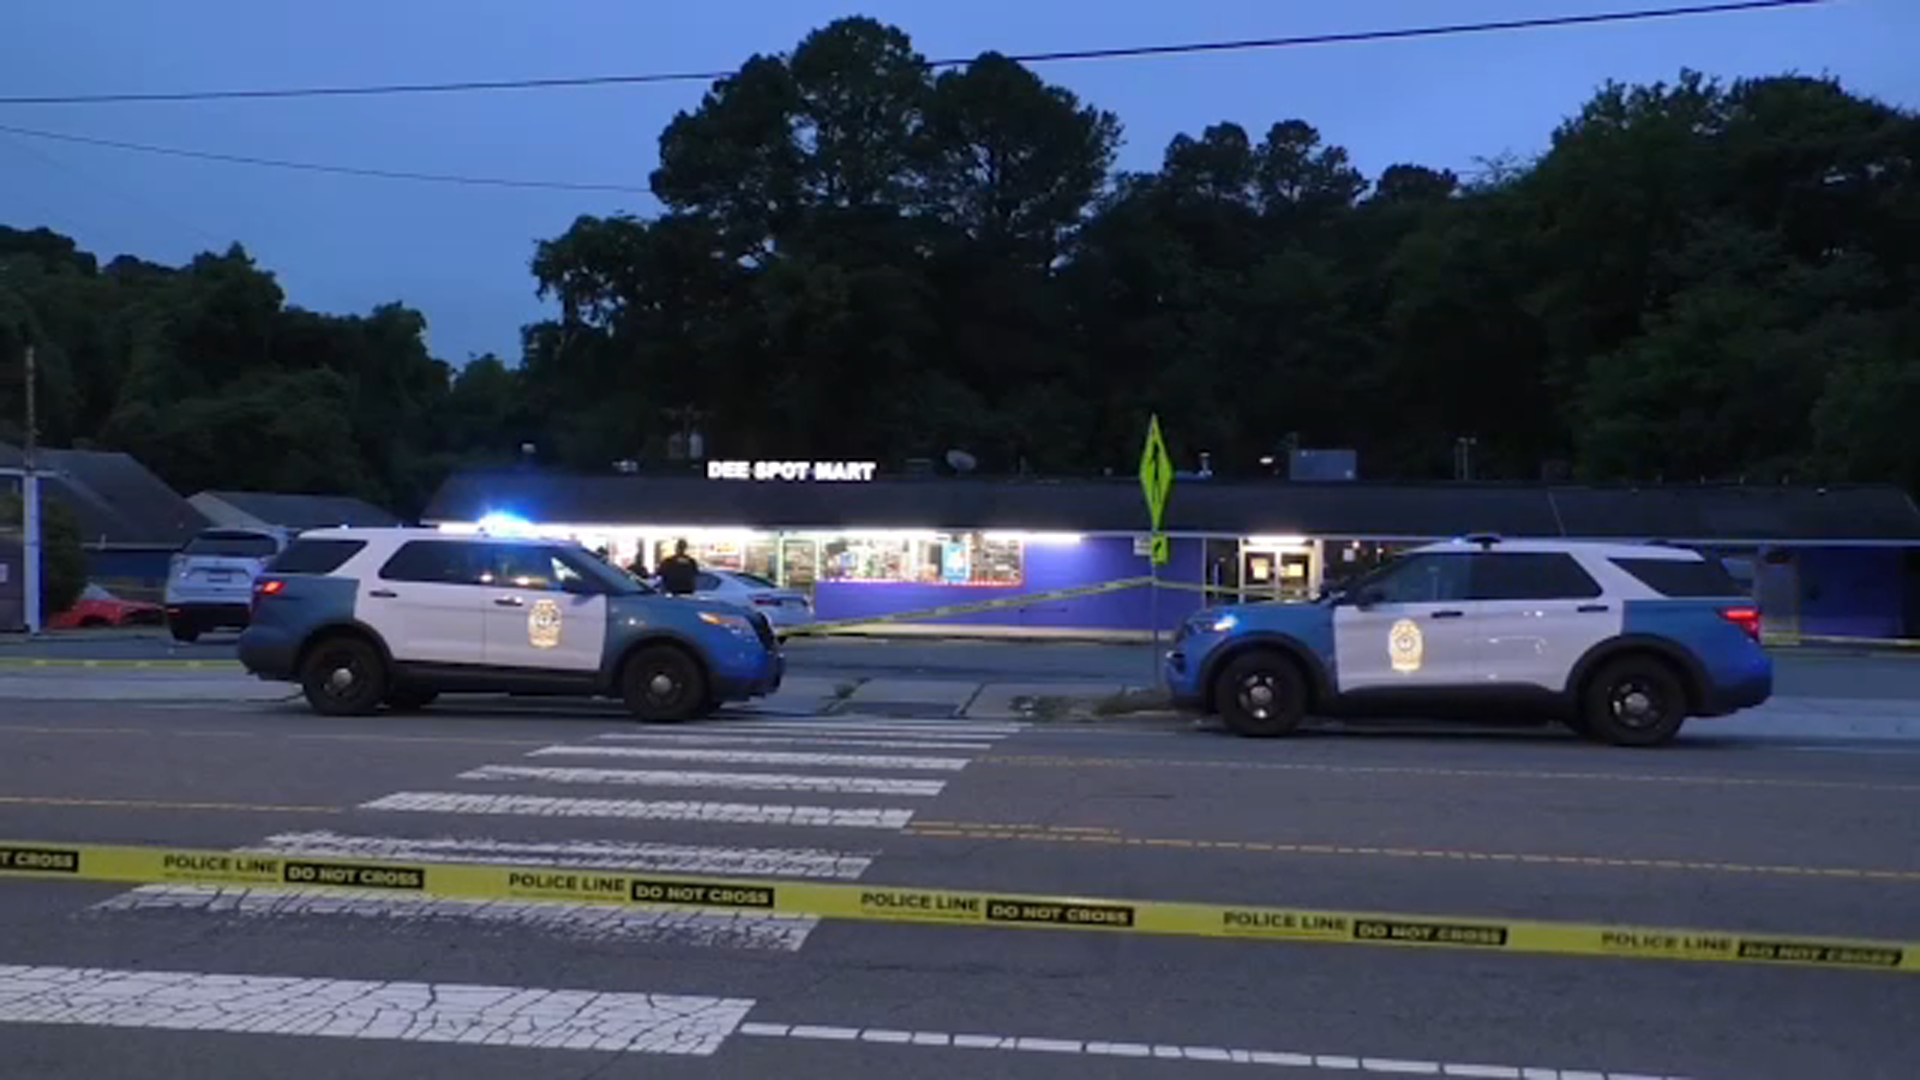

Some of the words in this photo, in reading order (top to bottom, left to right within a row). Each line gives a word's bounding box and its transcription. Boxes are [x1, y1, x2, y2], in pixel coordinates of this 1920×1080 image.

[707, 461, 750, 478] DEE
[754, 461, 810, 480] SPOT
[814, 462, 876, 481] MART
[14, 853, 74, 868] CROSS
[163, 855, 231, 871] POLICE
[236, 859, 278, 873] LINE
[287, 866, 313, 881] DO
[319, 868, 354, 883] NOT
[359, 871, 419, 887] CROSS
[509, 873, 577, 891] POLICE
[582, 876, 625, 893] LINE
[636, 885, 662, 898] DO
[668, 886, 703, 900] NOT
[709, 888, 769, 904] CROSS
[861, 892, 929, 909] POLICE
[935, 896, 979, 911] LINE
[991, 904, 1018, 918] DO
[1023, 905, 1060, 920] NOT
[1066, 907, 1128, 923] CROSS
[1223, 911, 1297, 928] POLICE
[1302, 915, 1346, 931] LINE
[1358, 923, 1385, 937] DO
[1392, 925, 1430, 940] NOT
[1437, 927, 1500, 943] CROSS
[1602, 932, 1678, 949] POLICE
[1684, 935, 1732, 952] LINE
